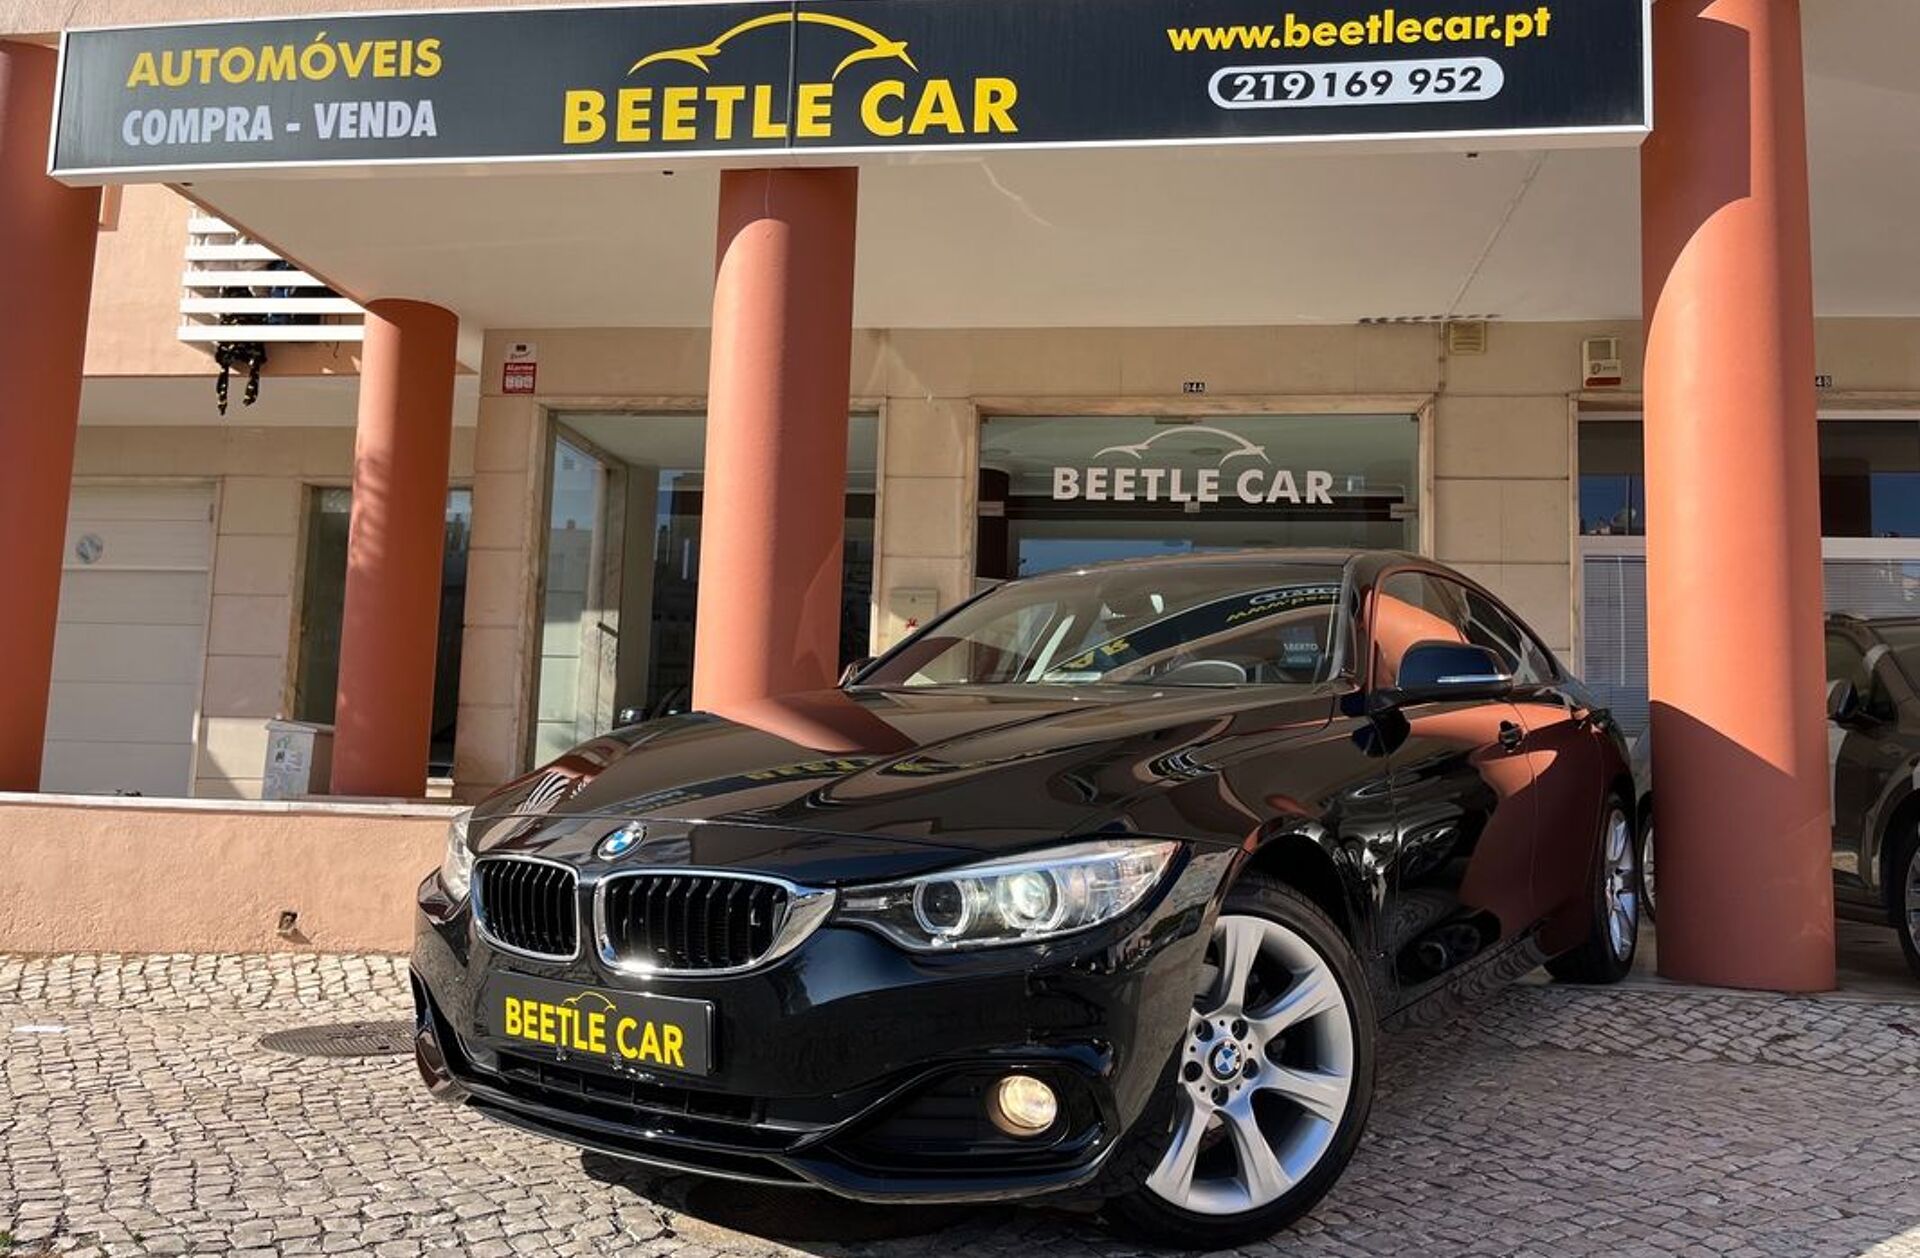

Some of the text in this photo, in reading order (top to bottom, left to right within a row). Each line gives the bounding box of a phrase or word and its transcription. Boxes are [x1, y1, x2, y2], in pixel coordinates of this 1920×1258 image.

[1167, 6, 1551, 51] www.beetlecar.pt
[127, 32, 443, 87] AUTOMÓVEIS
[1232, 66, 1483, 101] 219 169 952
[122, 104, 274, 146] COMPRA
[313, 99, 438, 140] VENDA
[563, 77, 1018, 145] BEETLE CAR
[1053, 467, 1333, 504] BEETLE CAR
[505, 996, 685, 1068] BEETLE CAR
